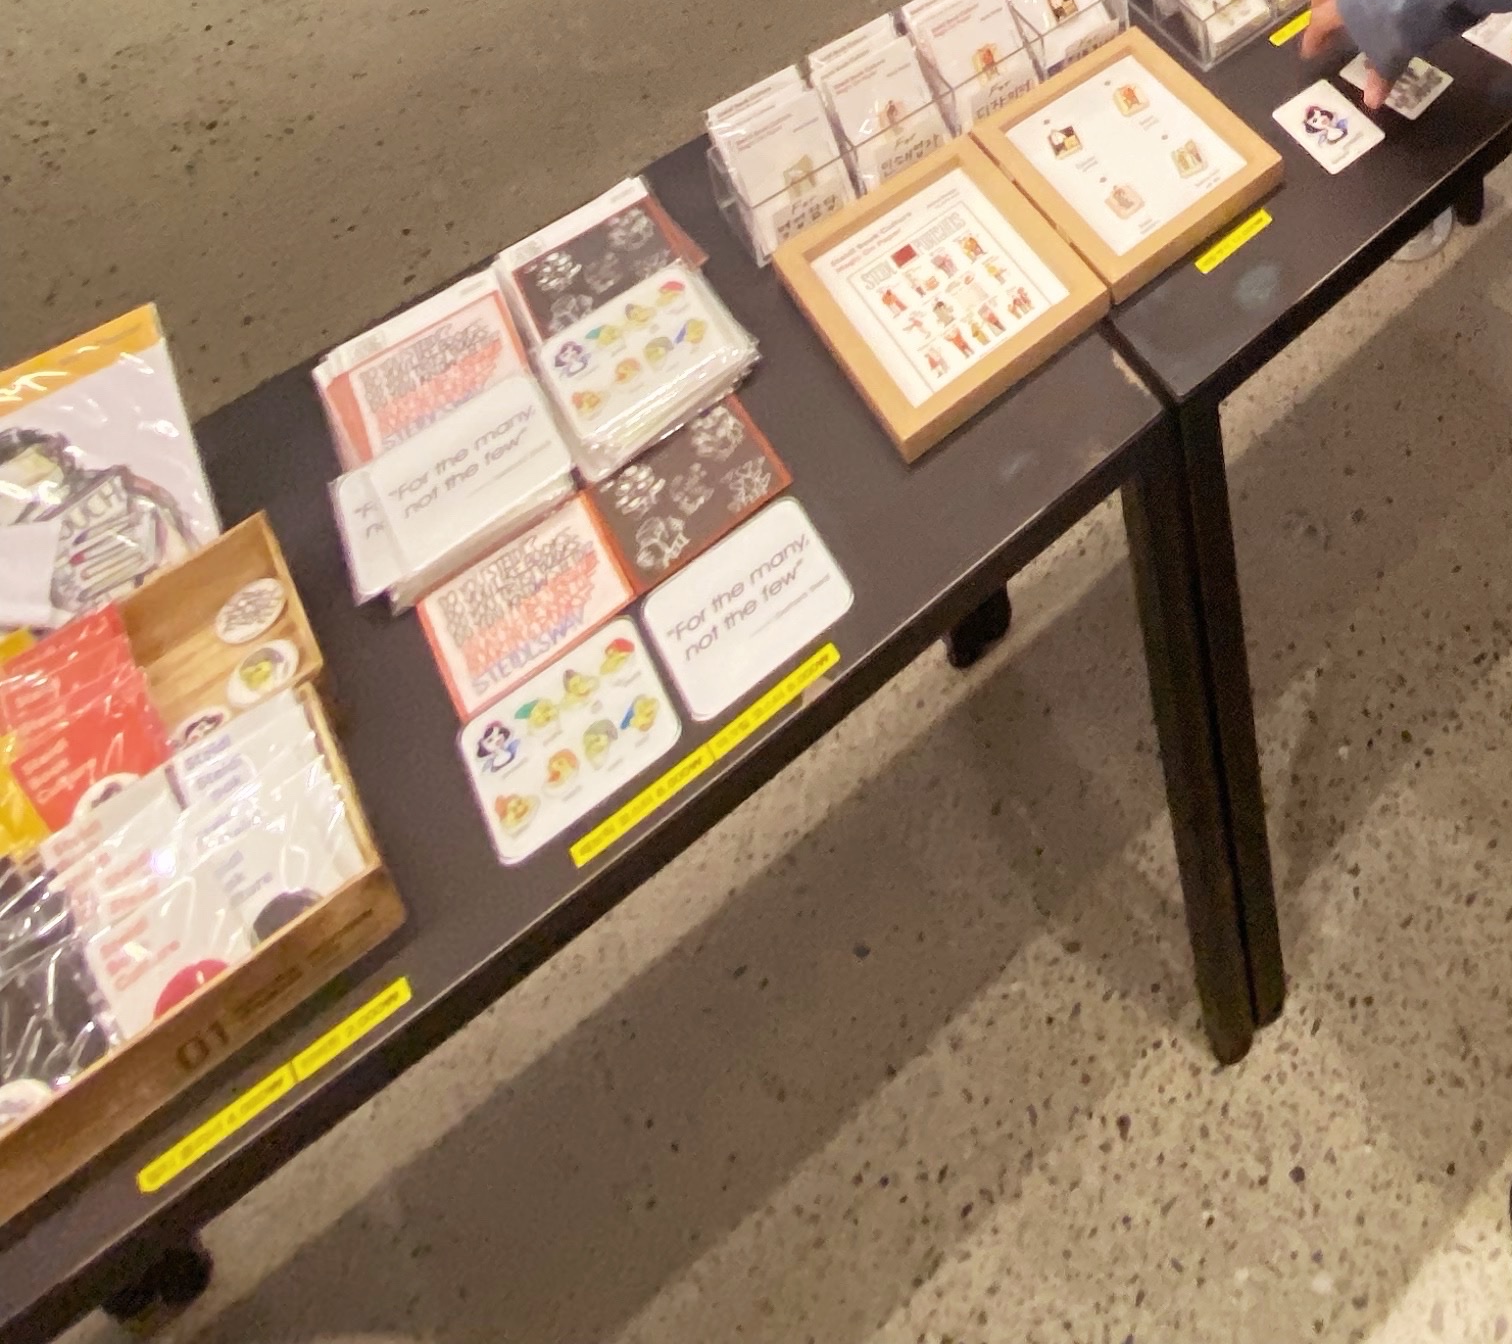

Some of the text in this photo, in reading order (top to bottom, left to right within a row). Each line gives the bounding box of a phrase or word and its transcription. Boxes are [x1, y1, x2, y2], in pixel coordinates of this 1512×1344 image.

[711, 581, 745, 613] the
[685, 625, 719, 662] not
[723, 599, 759, 631] the
